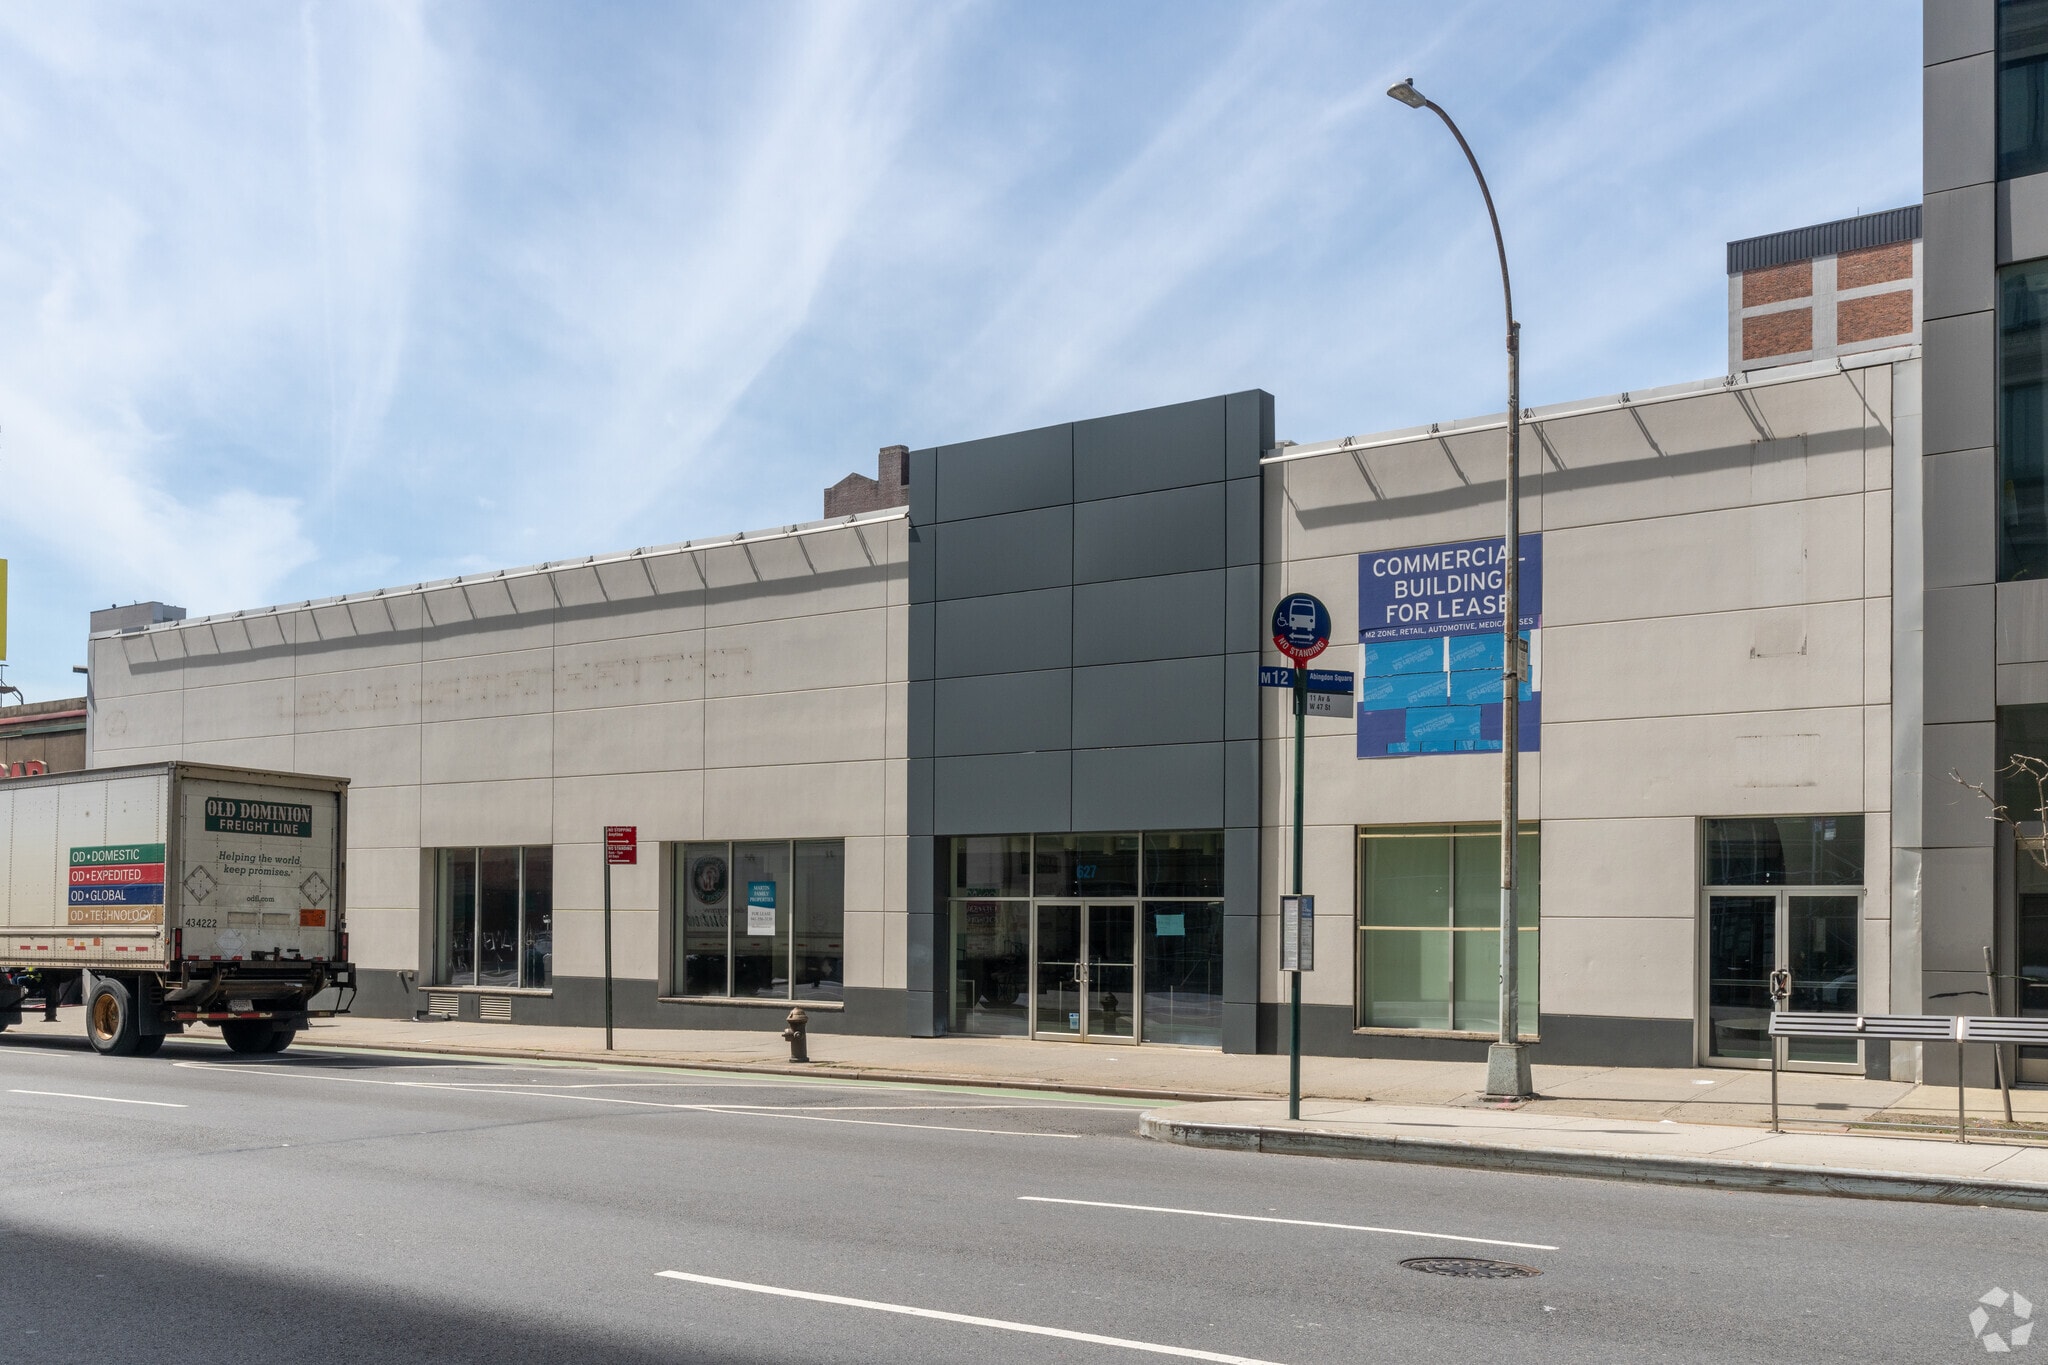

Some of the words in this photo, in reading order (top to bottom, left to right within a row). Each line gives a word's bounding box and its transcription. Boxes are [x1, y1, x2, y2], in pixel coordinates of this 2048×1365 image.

[1395, 570, 1502, 599] BUILDING
[1386, 602, 1429, 624] FOR
[1377, 629, 1399, 637] ZONE,
[1400, 627, 1427, 636] RETAIL,
[1428, 622, 1478, 634] AUTOMOTIVE,
[1479, 620, 1506, 628] MEDICA
[1518, 617, 1534, 626] SES
[1278, 637, 1290, 649] NO
[1290, 640, 1325, 657] STANDING
[1261, 670, 1289, 685] M12
[1309, 672, 1333, 682] Abingdon
[1334, 674, 1353, 682] Square
[207, 800, 236, 817] OLD
[240, 803, 310, 823] DOMINION
[219, 819, 269, 833] FREIGHT
[273, 823, 299, 835] LINE
[72, 852, 86, 863] OD
[91, 848, 140, 862] DOMESTIC
[218, 850, 256, 864] Helping
[258, 853, 273, 863] the
[275, 855, 301, 865] world
[71, 871, 85, 882] OD
[91, 868, 142, 881] EXPEDITED
[224, 864, 246, 876] keep
[1077, 864, 1097, 879] 627
[71, 890, 84, 901] OD
[90, 889, 127, 901] GLOBAL
[70, 910, 84, 921] OD
[90, 909, 153, 921] TECHNOLOGY
[185, 918, 218, 928] 434222
